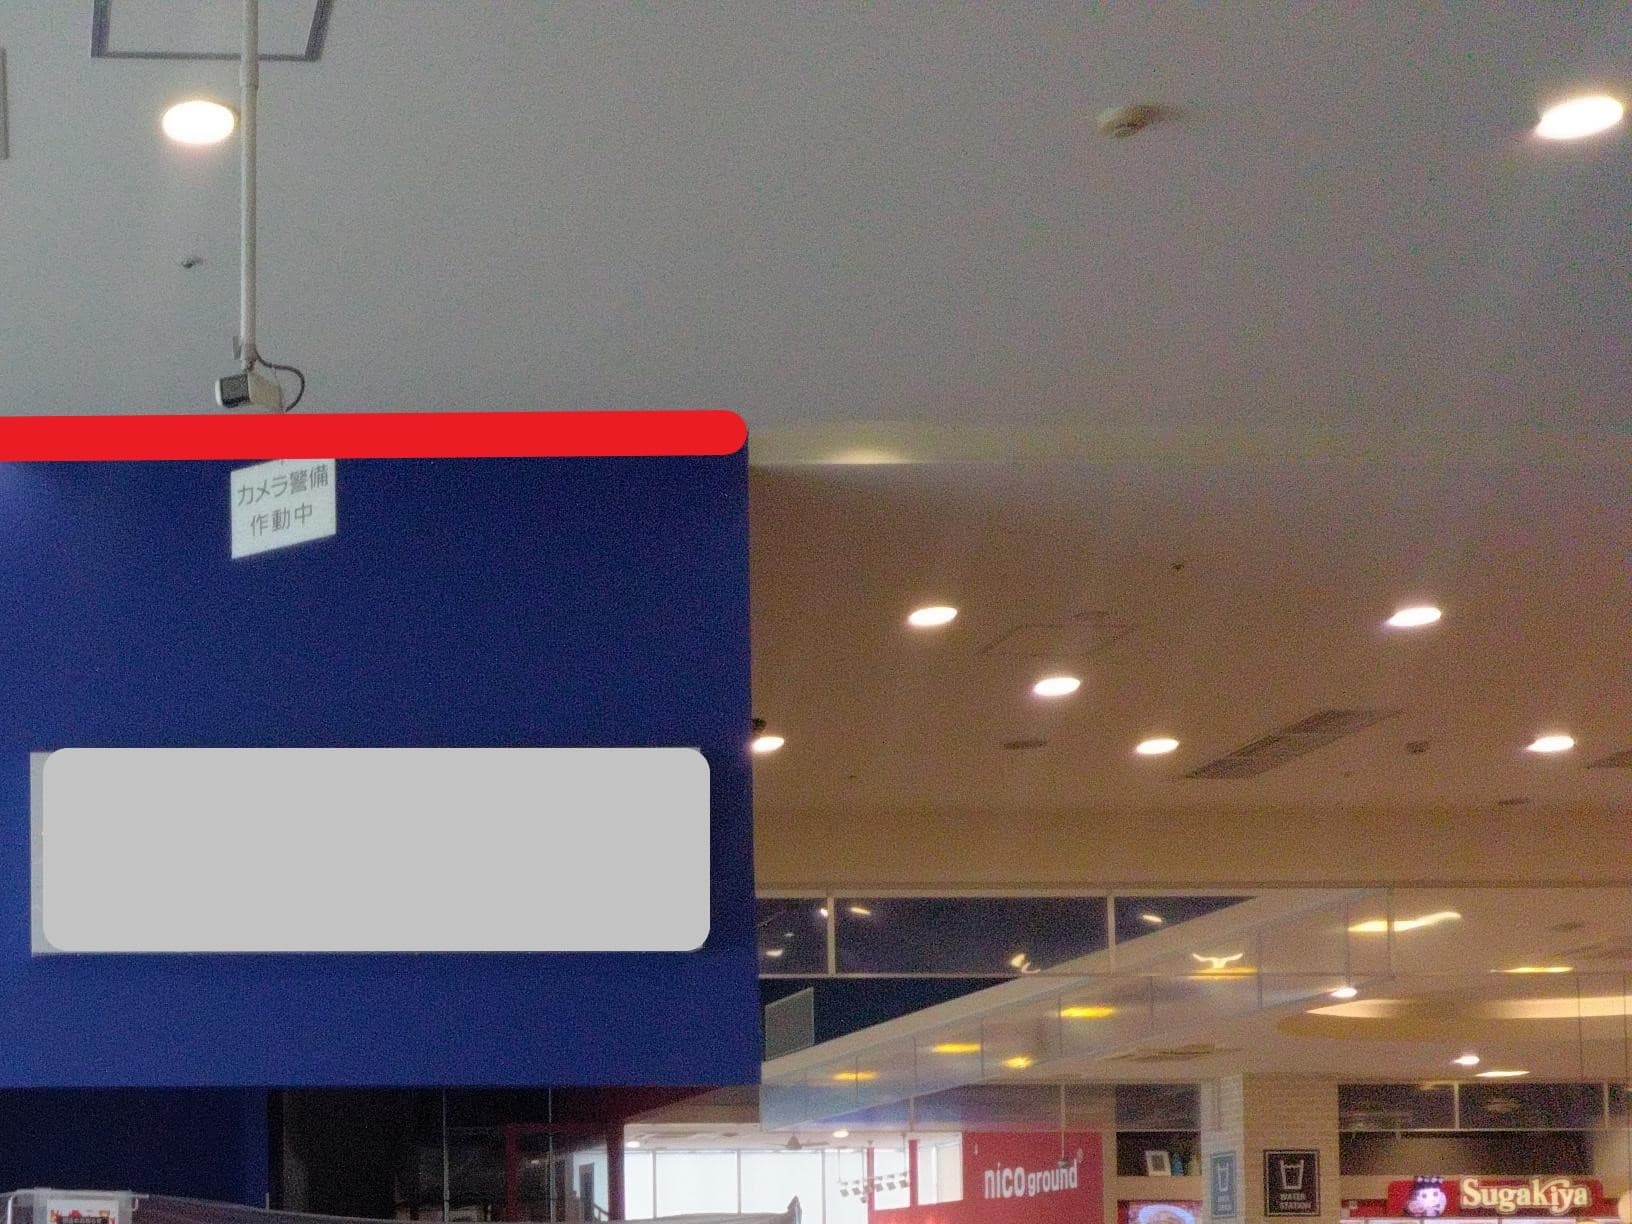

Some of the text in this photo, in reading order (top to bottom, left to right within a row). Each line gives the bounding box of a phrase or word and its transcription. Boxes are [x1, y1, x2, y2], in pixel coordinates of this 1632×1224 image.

[237, 464, 329, 506] カメラ警備
[250, 502, 313, 537] 作動中
[984, 1158, 1078, 1199] nico ground
[1279, 1191, 1307, 1201] WATER
[1460, 1177, 1593, 1215] Sugakiya
[1279, 1201, 1312, 1211] STATION
